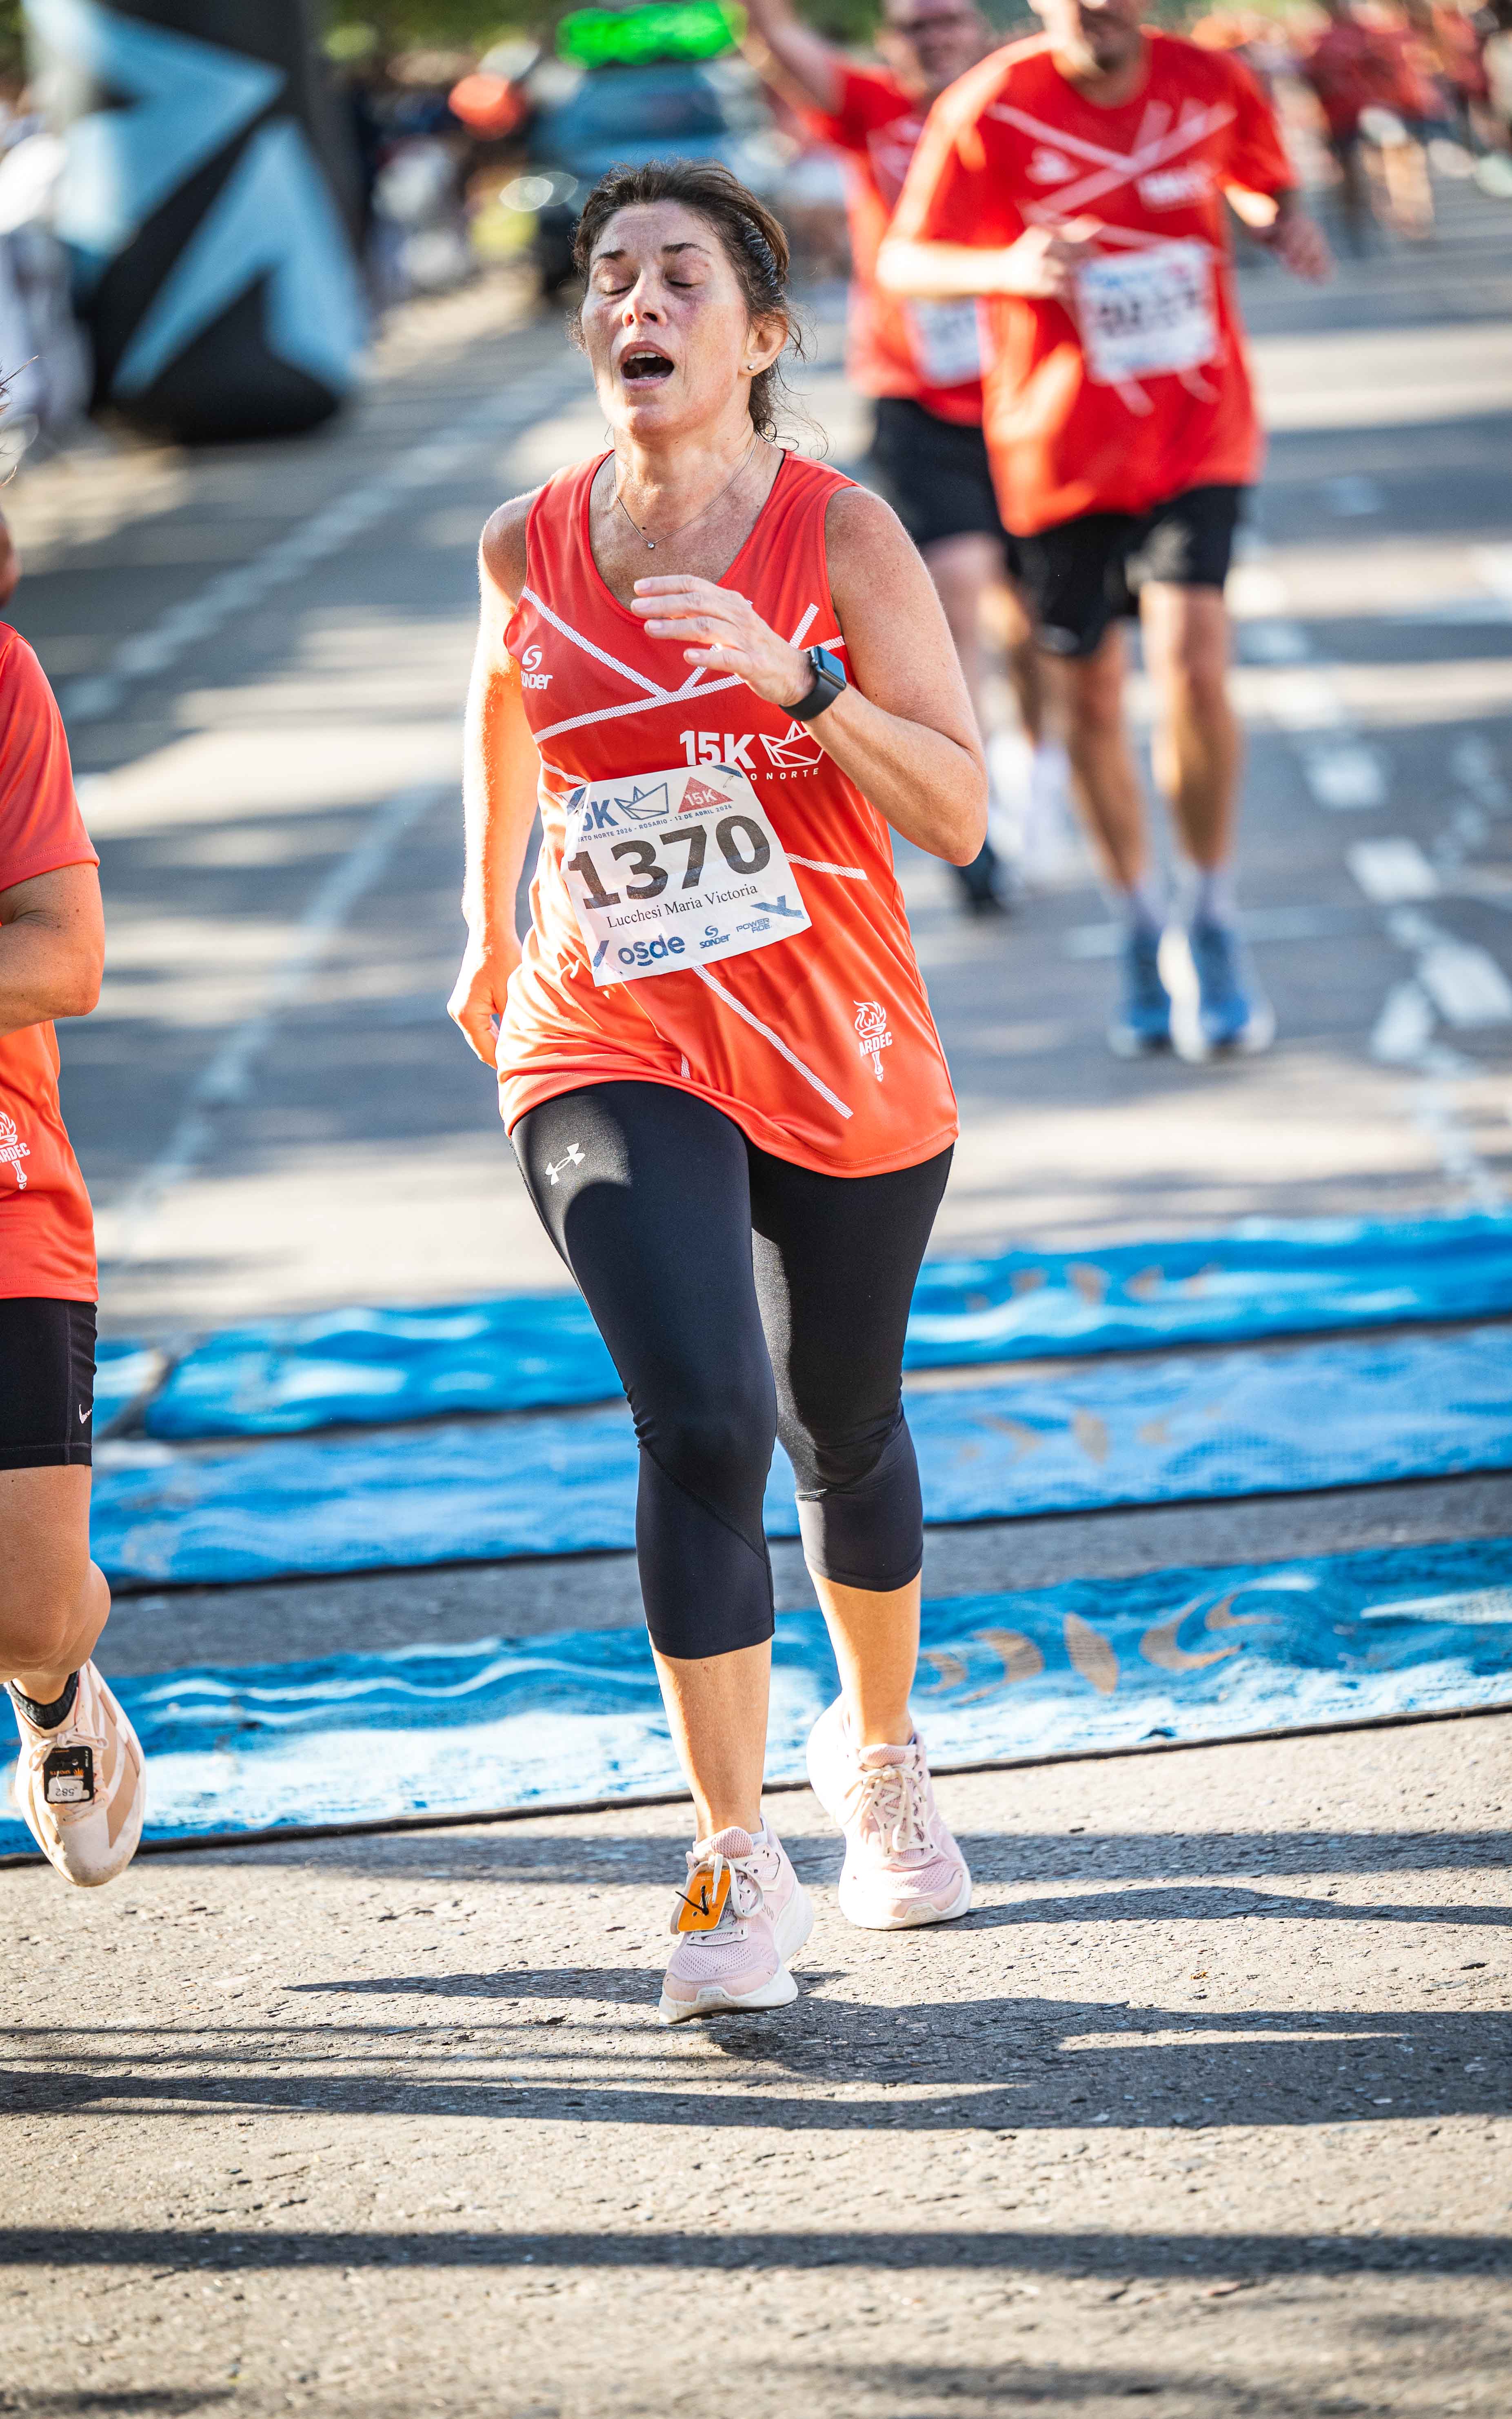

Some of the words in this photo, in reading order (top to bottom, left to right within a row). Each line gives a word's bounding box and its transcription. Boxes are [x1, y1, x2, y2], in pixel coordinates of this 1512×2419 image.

[680, 730, 757, 769] 15K
[766, 768, 819, 780] NORTE
[684, 789, 717, 806] 15K
[594, 831, 615, 840] NORTE
[639, 819, 667, 829] ROSARIO
[715, 804, 732, 812] 2026
[568, 815, 771, 909] 1370
[606, 905, 662, 928] Lucchesi
[663, 897, 702, 915] Maria
[704, 884, 757, 904] Victoria
[736, 917, 770, 932] POWER
[617, 933, 685, 966] osde
[859, 1031, 893, 1057] ARDEC
[56, 1788, 75, 1797] 582
